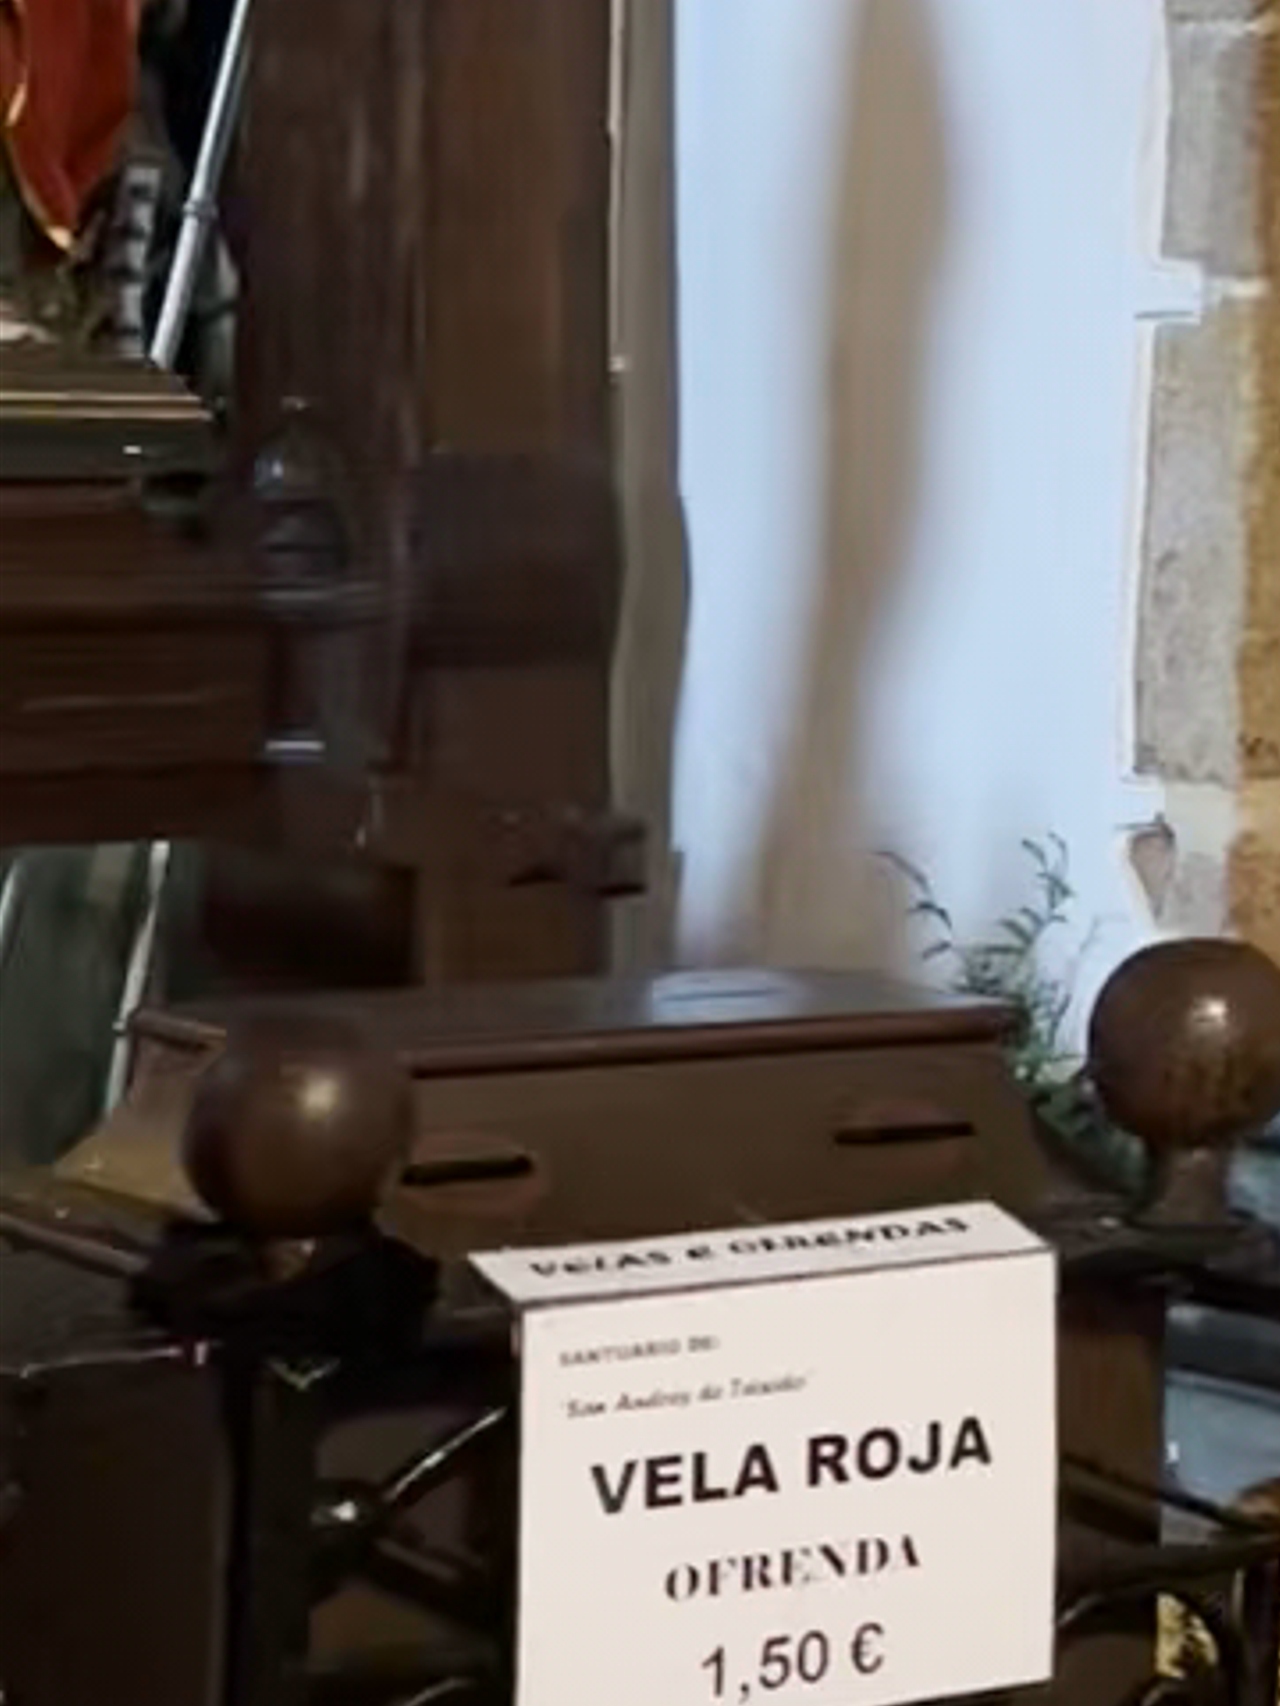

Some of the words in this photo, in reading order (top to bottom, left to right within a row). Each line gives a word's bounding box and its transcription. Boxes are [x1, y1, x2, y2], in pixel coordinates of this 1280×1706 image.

[529, 1250, 671, 1277] VELAS
[728, 1217, 968, 1255] OFRENDAS
[559, 1338, 681, 1367] SANTUARIO
[591, 1445, 780, 1515] VELA
[806, 1416, 992, 1487] ROJA
[664, 1534, 921, 1602] OFRENDA
[701, 1629, 829, 1703] 1,50
[851, 1622, 884, 1674] €
